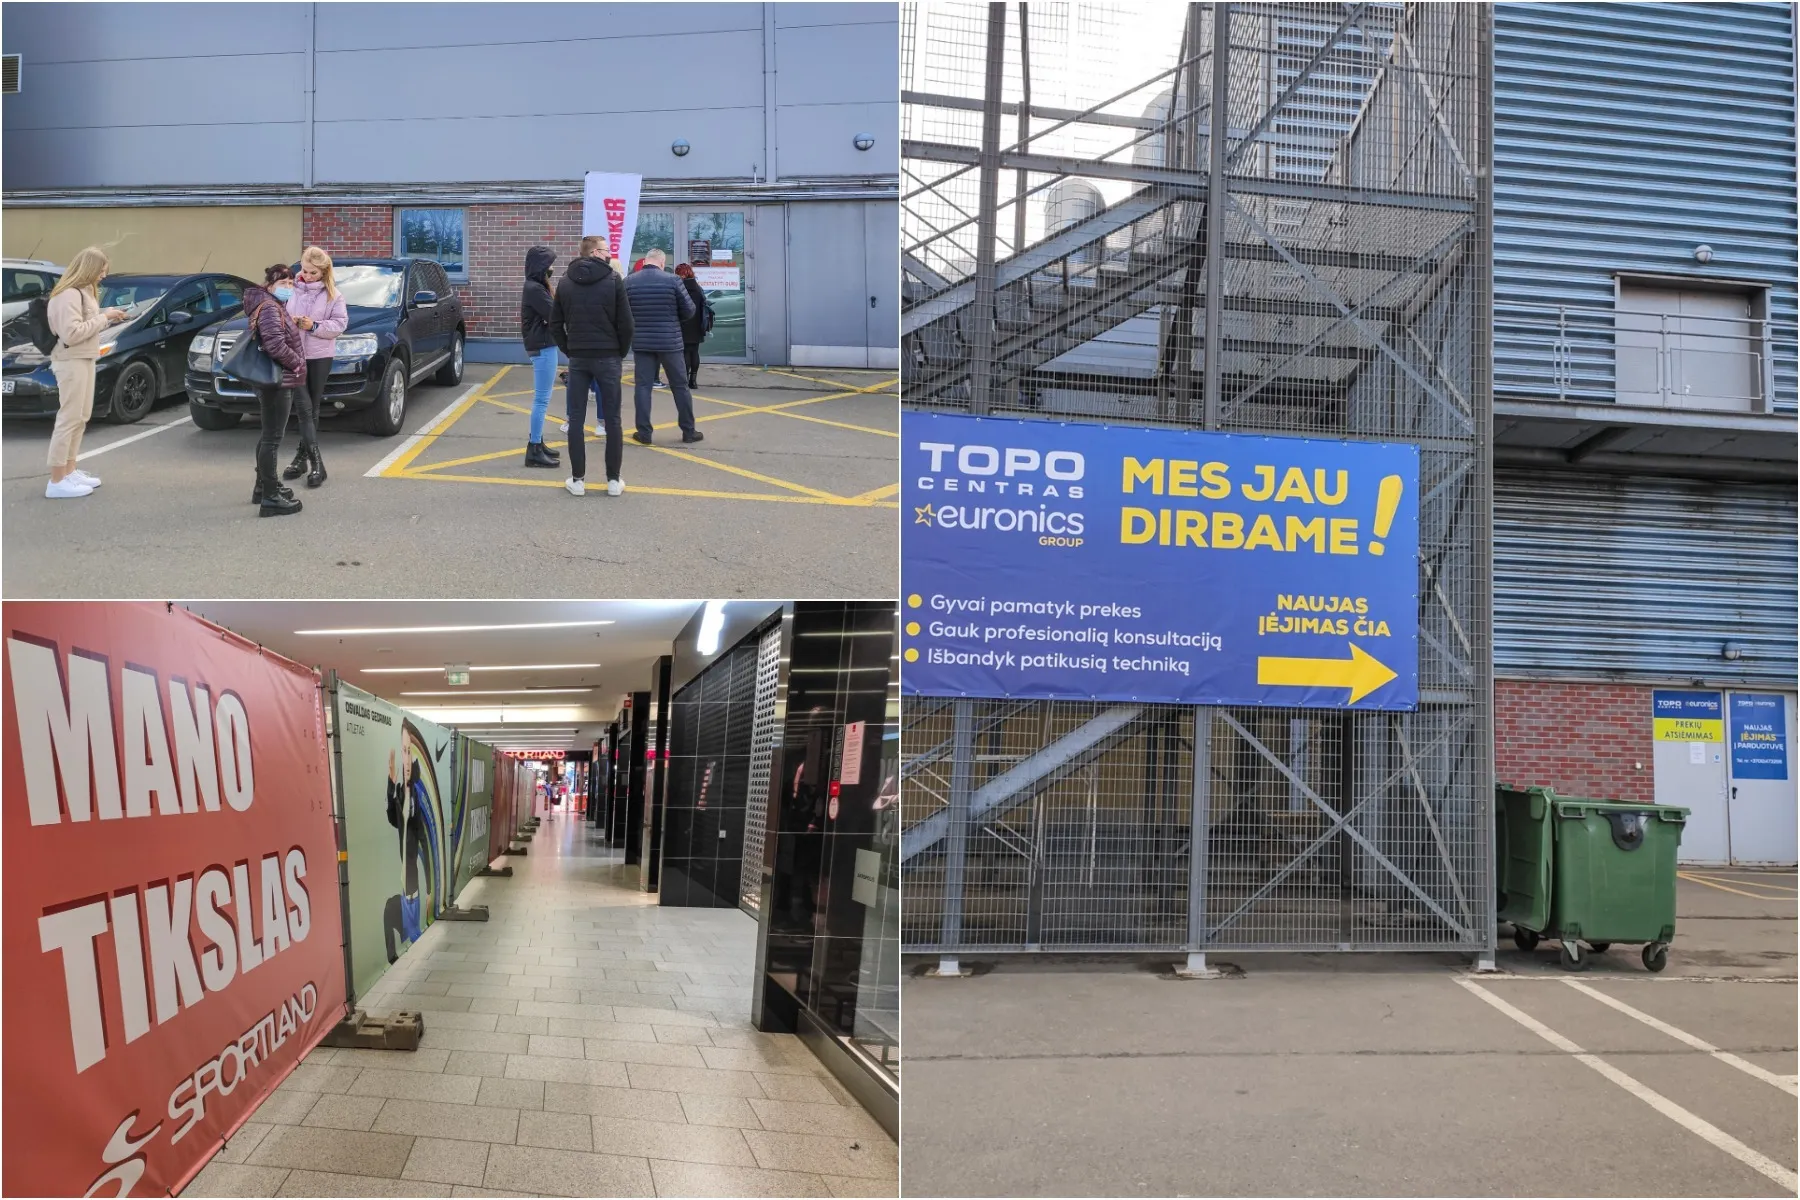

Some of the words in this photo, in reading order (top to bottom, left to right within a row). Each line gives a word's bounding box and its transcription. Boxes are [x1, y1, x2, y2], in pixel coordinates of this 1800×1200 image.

[603, 198, 626, 259] ORKER
[919, 442, 1085, 481] TOPO
[917, 476, 1084, 499] CENTRAS
[1122, 456, 1231, 499] MES
[1241, 464, 1349, 506] JAU
[937, 503, 1085, 535] euronics
[1038, 536, 1084, 548] GROUP
[930, 594, 985, 614] Gyvai
[990, 600, 1075, 619] pamatyk
[1080, 603, 1141, 620] prekes
[1277, 594, 1369, 614] NAUJAS
[928, 621, 980, 638] Gauk
[984, 625, 1109, 647] profesionalią
[1113, 628, 1222, 651] konsultaciją
[1258, 611, 1350, 636] ĮĖJIMAS
[1353, 615, 1392, 637] ČIA
[927, 648, 1016, 670] Išbandyk
[1020, 653, 1107, 673] patikusią
[1112, 657, 1190, 676] techniką
[6, 637, 255, 826] MANO
[37, 848, 312, 1074] TIKSLAS
[167, 981, 319, 1146] SPORTLAND
